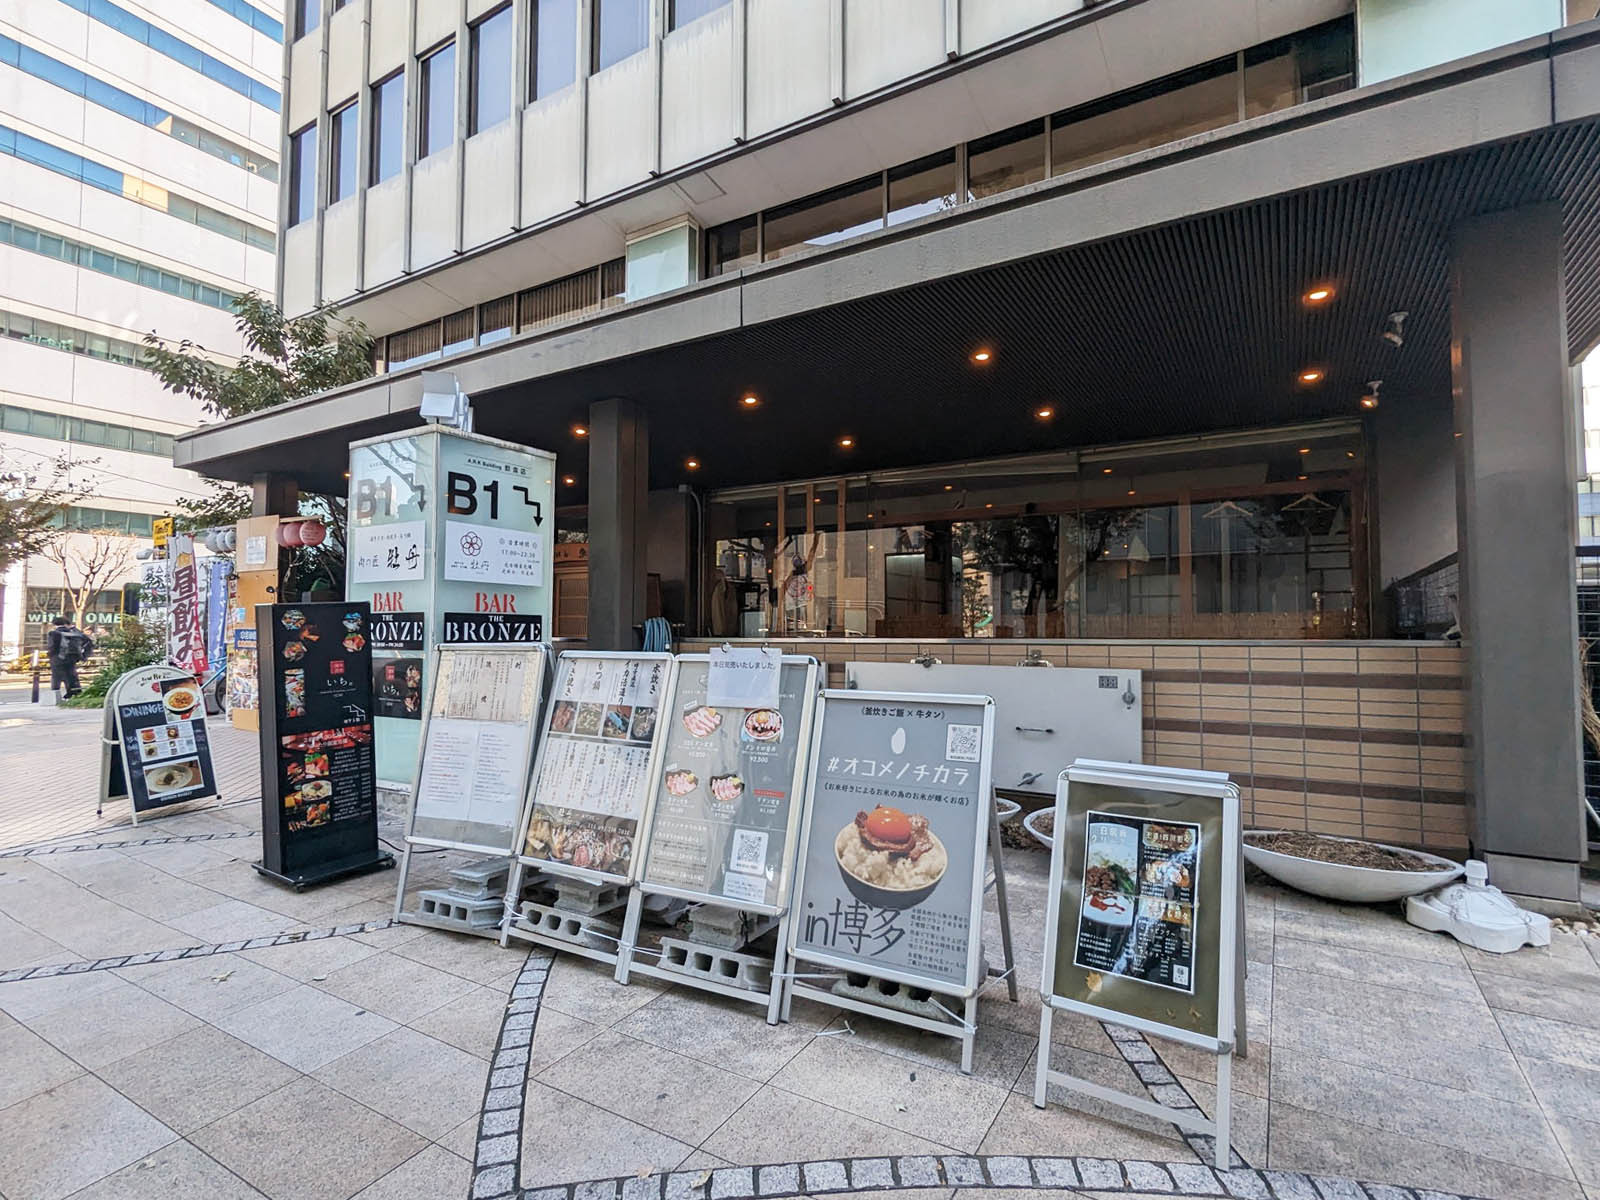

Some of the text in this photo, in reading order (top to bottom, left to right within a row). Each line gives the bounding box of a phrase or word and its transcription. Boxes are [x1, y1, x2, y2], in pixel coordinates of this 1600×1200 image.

[357, 475, 392, 520] B1
[447, 471, 499, 520] B1
[373, 592, 404, 612] BAR
[475, 592, 517, 613] BAR
[172, 565, 197, 662] 昼飲み
[382, 614, 394, 622] THE
[488, 615, 504, 623] THE
[445, 622, 541, 642] BRONZE
[713, 661, 776, 670] 本日完売いたしました。
[827, 757, 969, 785] #オコメノチカラ
